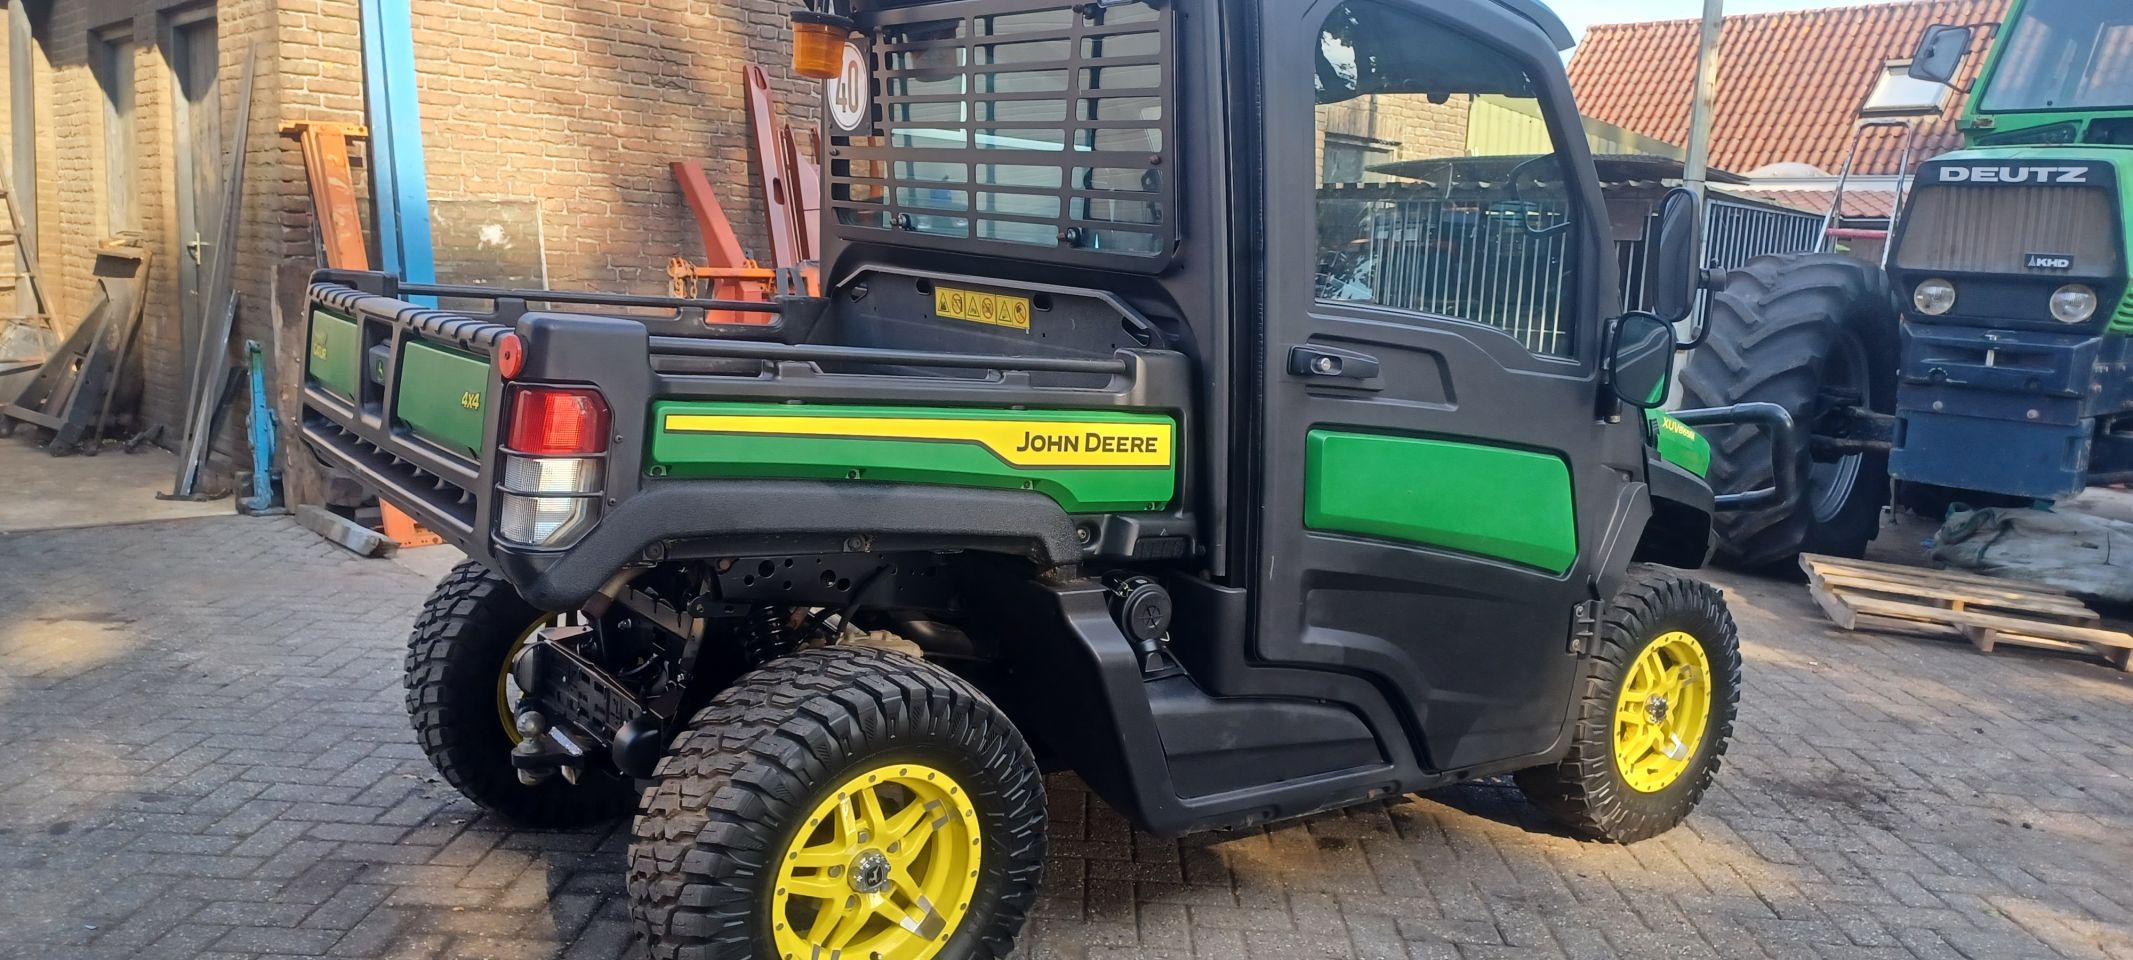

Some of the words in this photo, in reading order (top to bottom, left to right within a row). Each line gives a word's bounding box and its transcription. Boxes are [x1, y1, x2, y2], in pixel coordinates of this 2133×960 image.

[835, 60, 859, 113] 40
[1939, 166, 2089, 183] DEUTZ
[2036, 257, 2070, 268] KHD
[1016, 431, 1079, 453] JOHN
[1085, 432, 1158, 453] DEERE
